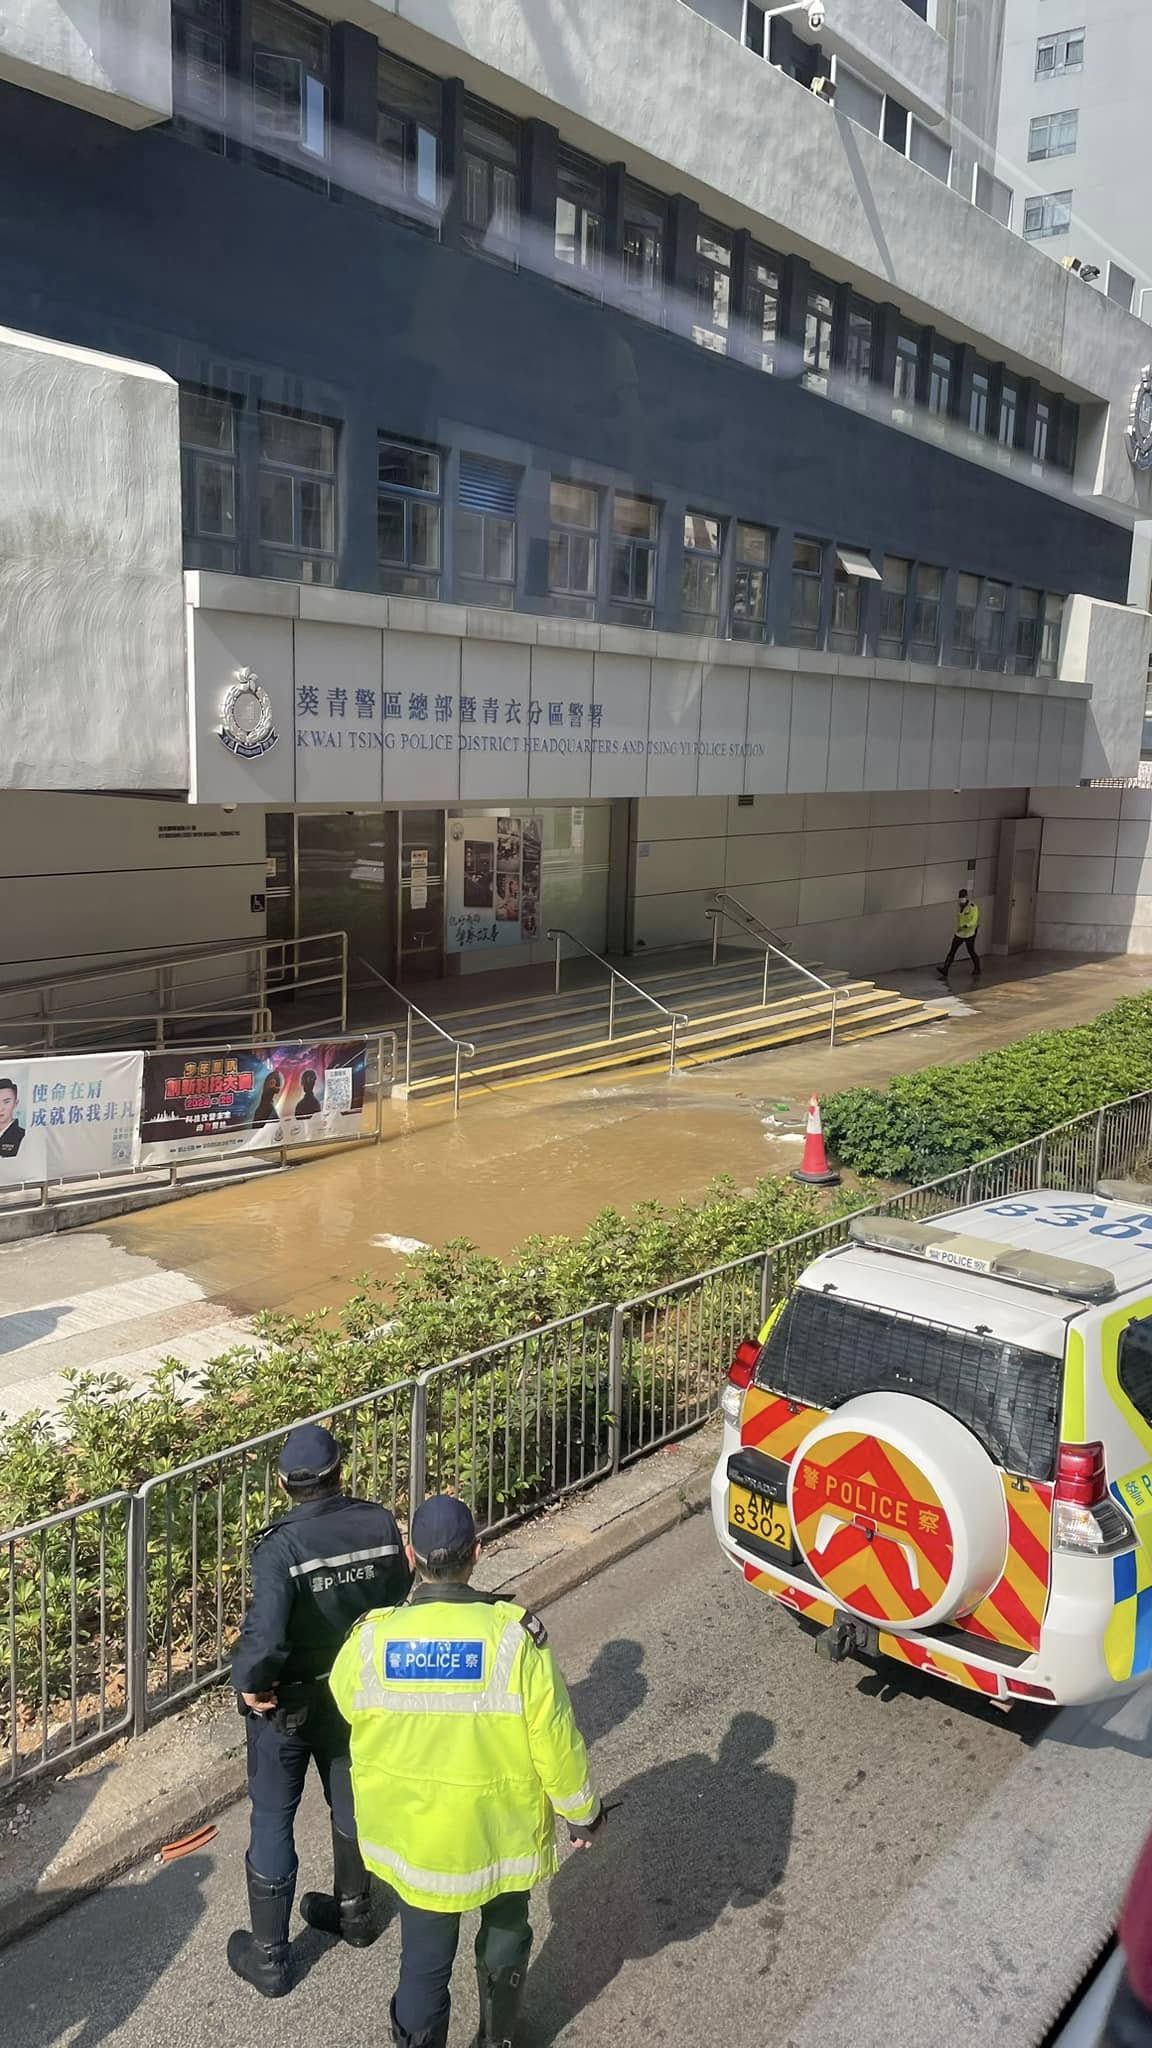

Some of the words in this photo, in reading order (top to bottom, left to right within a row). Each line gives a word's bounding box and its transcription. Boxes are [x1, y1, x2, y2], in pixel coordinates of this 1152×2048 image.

[296, 685, 604, 729] 葵青警區總部暨青衣分區警署
[297, 730, 342, 748] KWAI
[348, 731, 395, 749] TSING
[400, 733, 453, 750] POLICE
[458, 735, 519, 752] DISTRICT
[523, 737, 618, 756] HEADQUARTERS
[621, 740, 645, 754] AND
[647, 740, 677, 755] TSING
[679, 741, 691, 755] YI
[692, 742, 726, 756] POLICE
[729, 743, 766, 758] STATION
[33, 1080, 102, 1103] 使命在肩
[31, 1101, 135, 1127] 成就你我非凡
[984, 1204, 1152, 1251] 830
[942, 1252, 973, 1268] POLICE
[744, 1475, 777, 1495] PRADO
[748, 1494, 773, 1519] AM
[803, 1465, 820, 1490] 警
[826, 1475, 908, 1525] POLICE
[918, 1509, 940, 1536] 察
[734, 1504, 785, 1545] 8302
[405, 1653, 460, 1668] POLICE
[465, 1653, 478, 1668] 察
